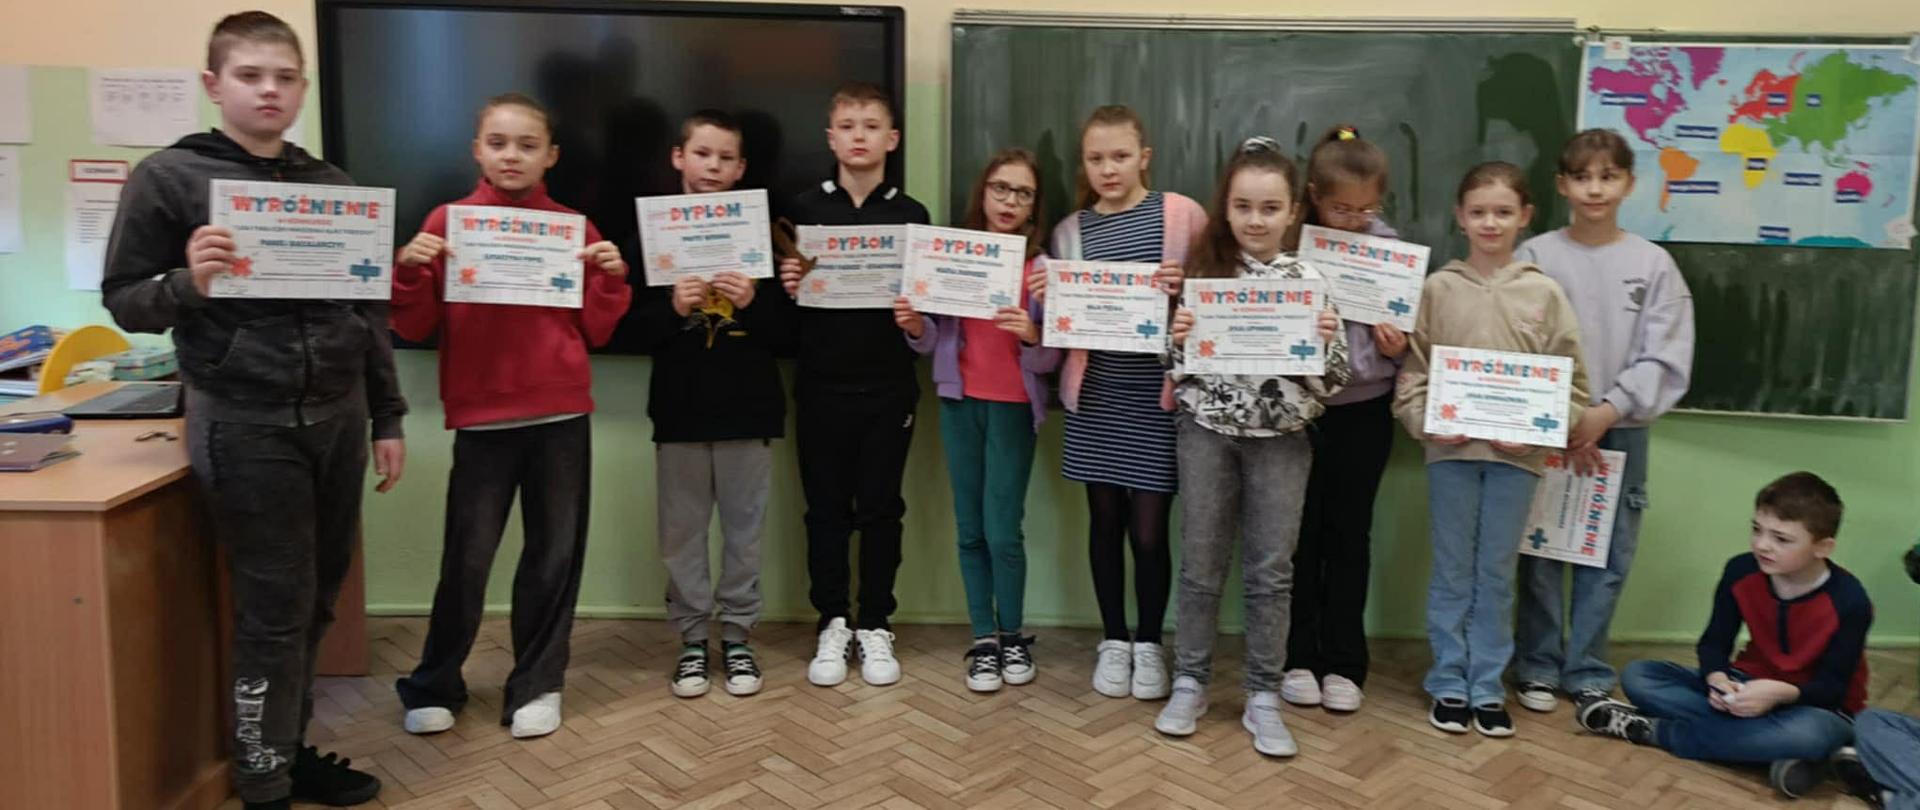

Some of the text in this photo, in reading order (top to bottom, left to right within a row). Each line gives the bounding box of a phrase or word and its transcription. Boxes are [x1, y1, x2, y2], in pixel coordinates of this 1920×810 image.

[231, 194, 380, 219] WYRÓŻNIENIE
[671, 203, 741, 221] DYPLOM
[463, 216, 573, 240] WYRÓŻNIENIE
[828, 236, 894, 251] DYPLOM
[933, 238, 999, 258] DYPLOM
[1314, 236, 1417, 268] WYRÓŻNIENIE
[1059, 269, 1160, 289] WYRÓŻNIENIE
[1200, 287, 1312, 306] WYRÓŻNIENIE
[1445, 357, 1559, 382] WYRÓŻNIENIE
[1581, 462, 1610, 556] WYRÓŻNIENIE
